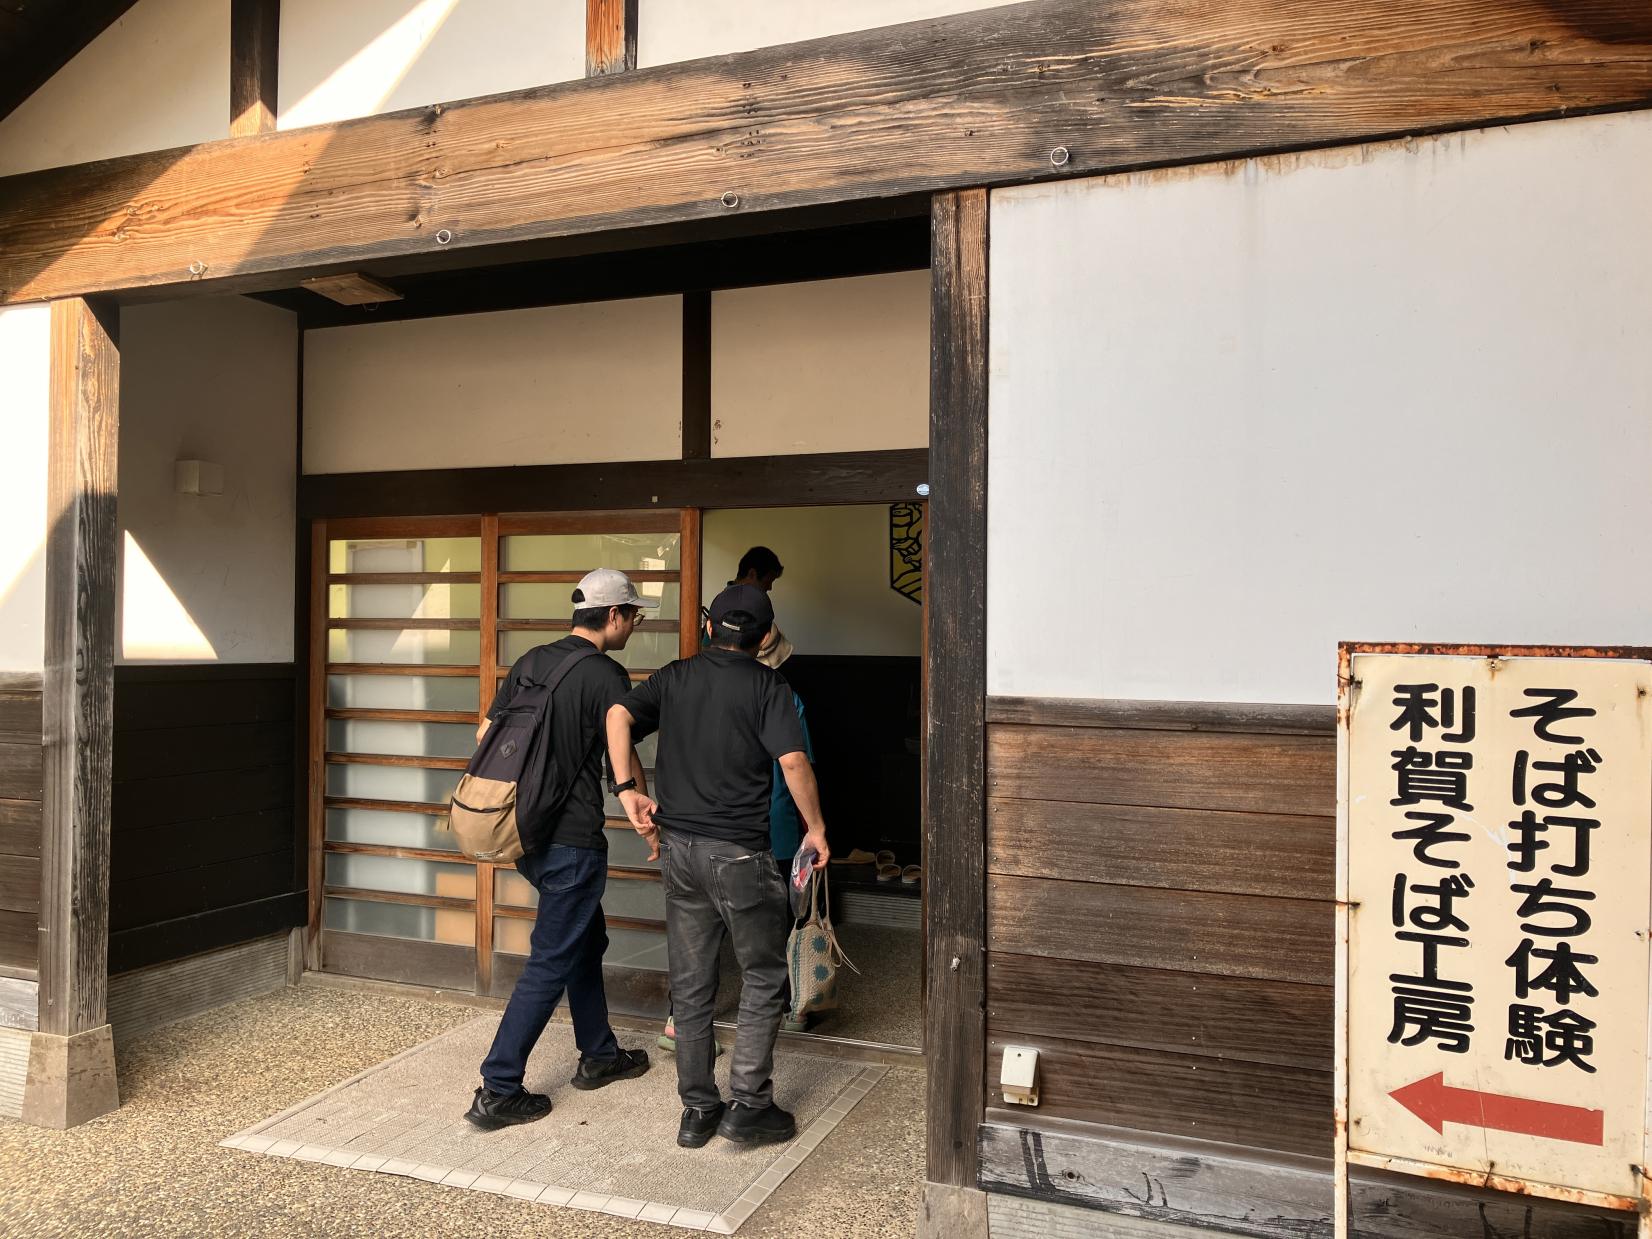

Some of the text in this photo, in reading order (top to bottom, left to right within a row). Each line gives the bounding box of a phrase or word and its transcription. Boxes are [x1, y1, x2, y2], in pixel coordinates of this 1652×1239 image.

[1387, 682, 1476, 1055] 利賀そば工房
[1504, 687, 1603, 1074] そば打ち体験
